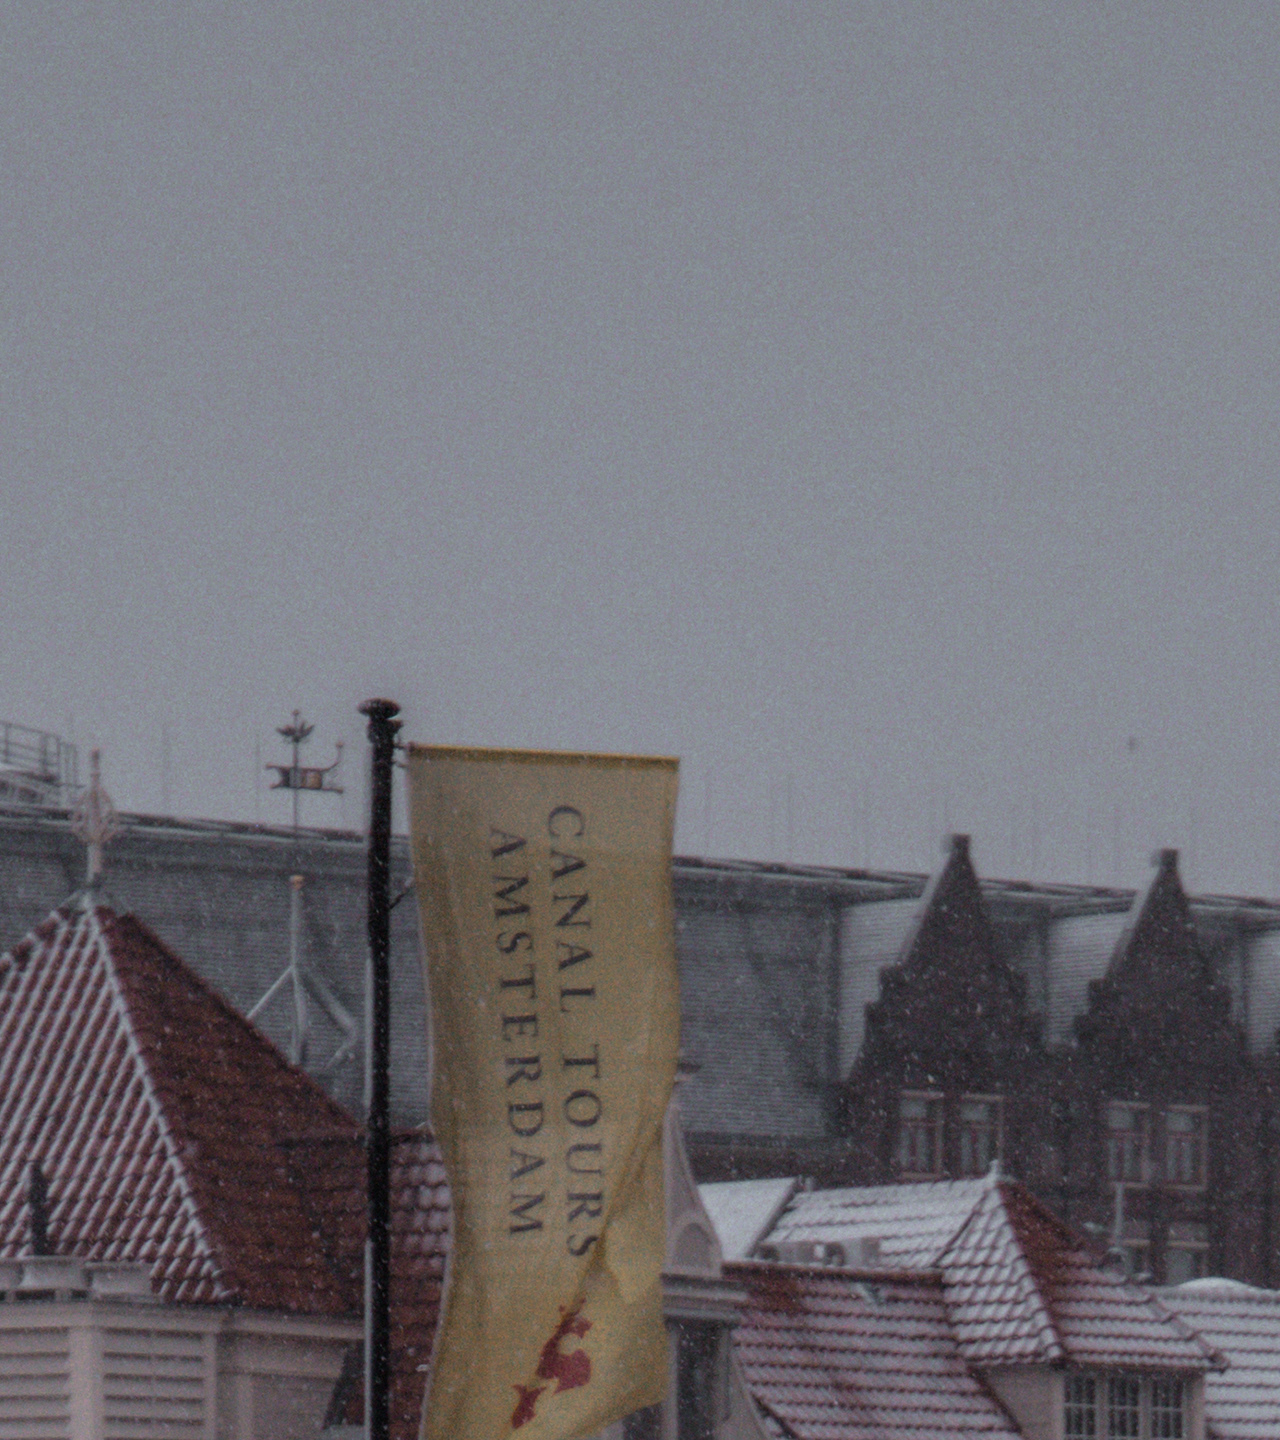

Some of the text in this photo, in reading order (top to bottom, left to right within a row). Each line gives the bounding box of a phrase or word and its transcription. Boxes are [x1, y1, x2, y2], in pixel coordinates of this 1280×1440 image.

[489, 827, 544, 1237] AMSTERDAM
[547, 805, 604, 1258] CANAL TOURS
